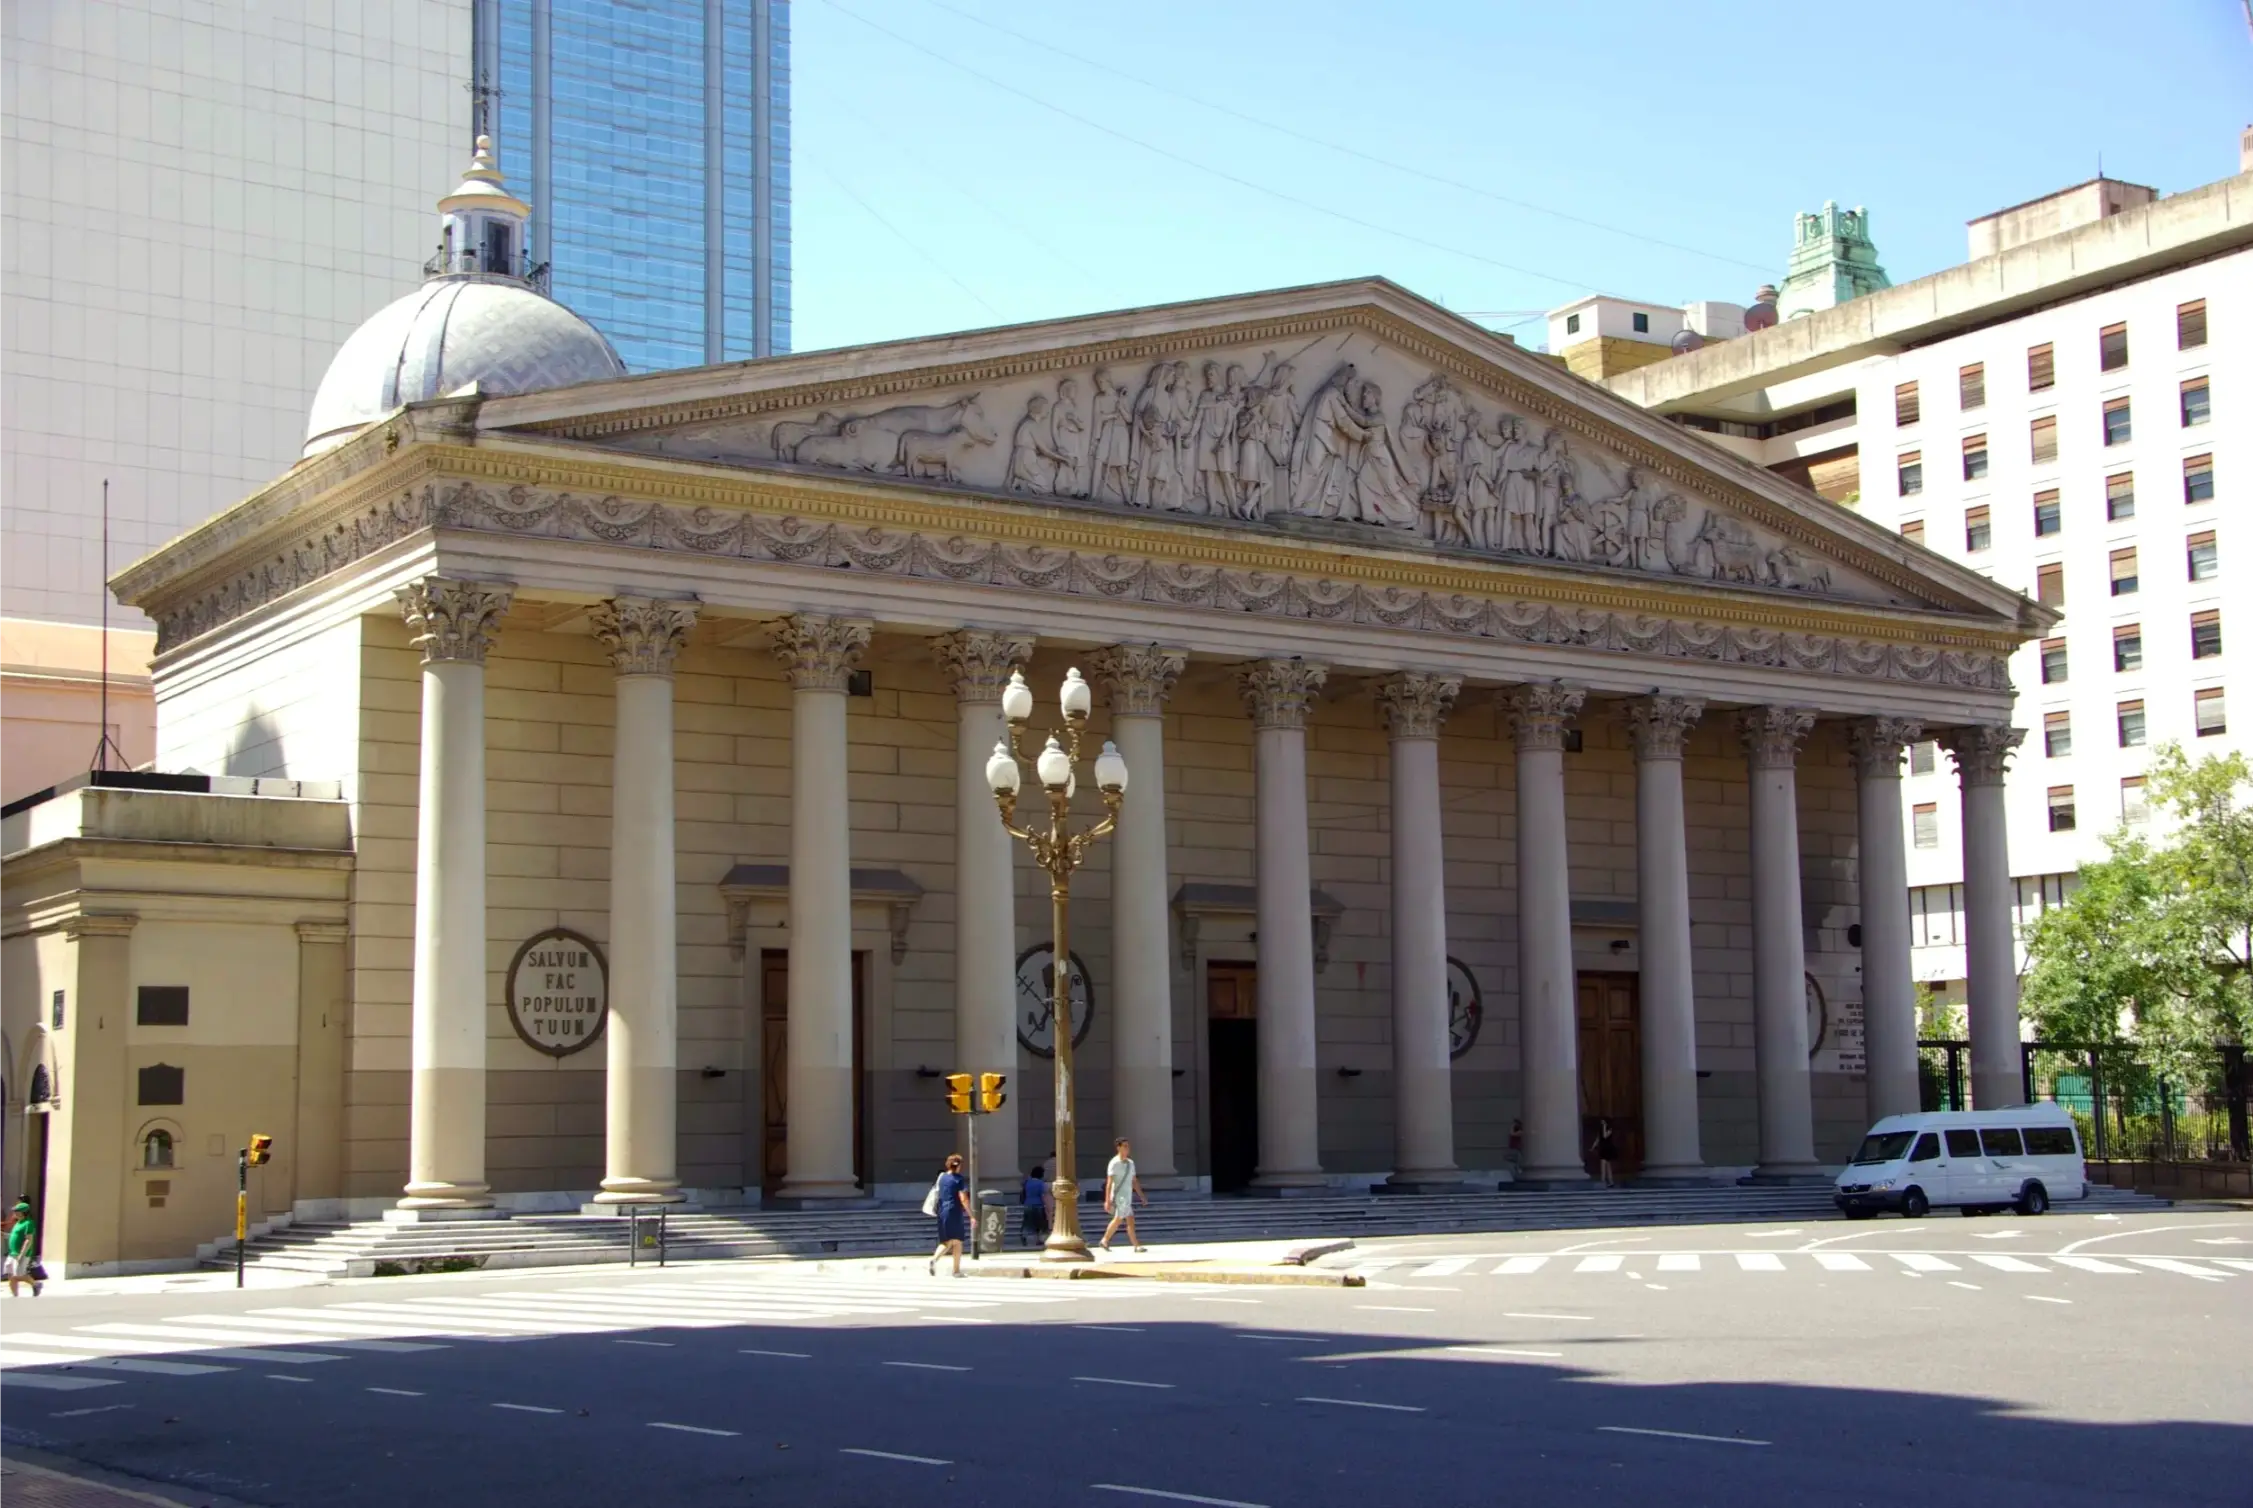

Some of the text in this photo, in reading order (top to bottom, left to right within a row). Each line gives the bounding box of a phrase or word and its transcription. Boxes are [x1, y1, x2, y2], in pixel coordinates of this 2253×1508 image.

[528, 951, 589, 967] SALVUM
[545, 973, 576, 990] FAC
[522, 996, 596, 1013] POPULUM
[533, 1019, 584, 1035] TUUM
